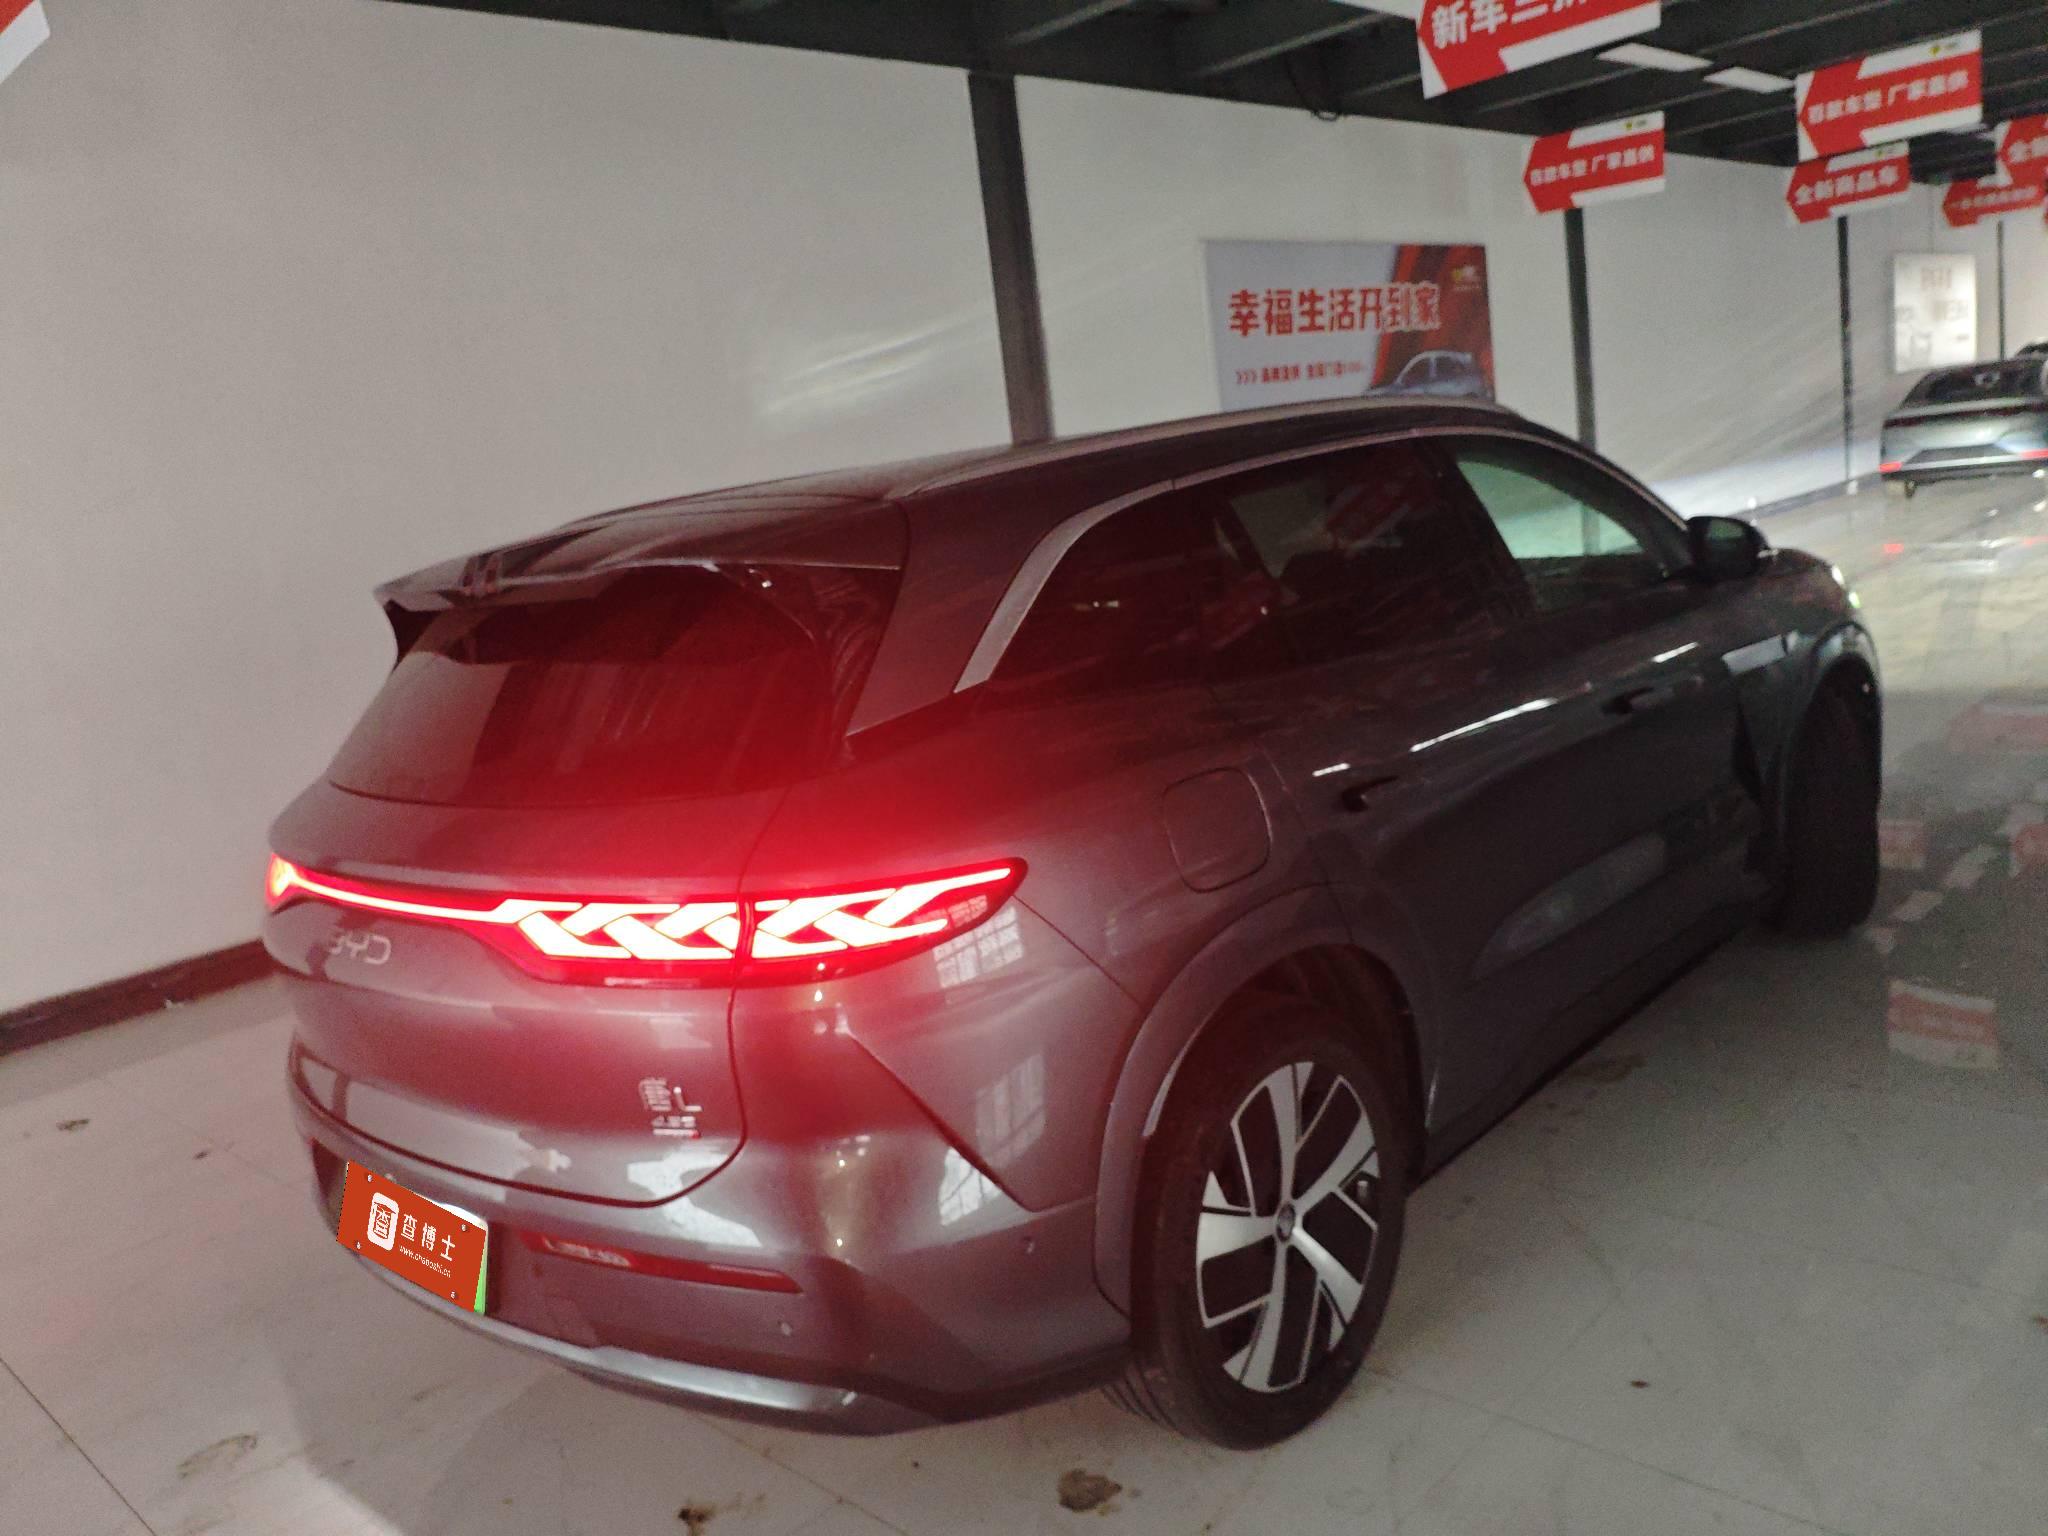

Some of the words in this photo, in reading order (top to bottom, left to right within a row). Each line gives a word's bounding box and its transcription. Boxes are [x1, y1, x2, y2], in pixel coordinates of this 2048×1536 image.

[1432, 0, 1589, 49] 新车三
[1228, 281, 1441, 338] 幸福生活开到家
